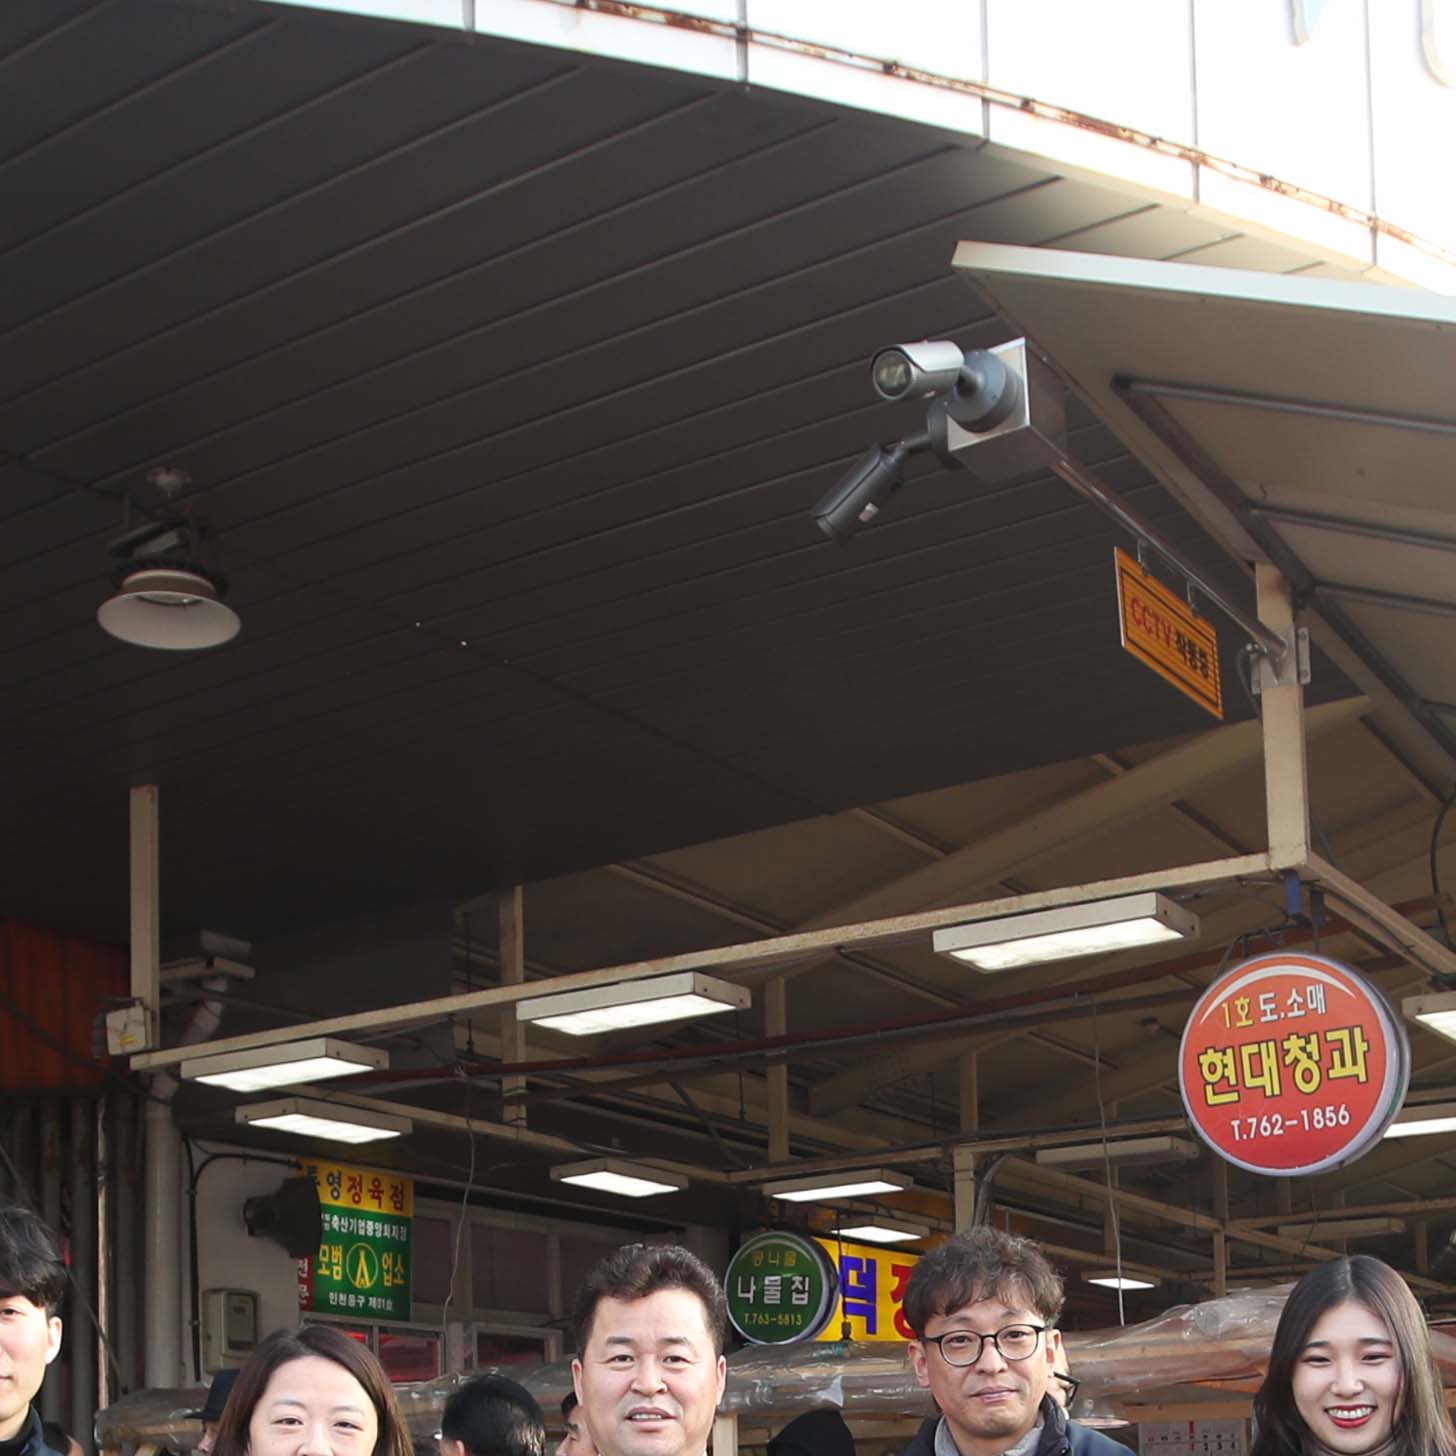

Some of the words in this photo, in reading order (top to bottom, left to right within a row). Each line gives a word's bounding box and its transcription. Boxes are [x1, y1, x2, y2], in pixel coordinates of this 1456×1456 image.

[1221, 996, 1253, 1029] 1호
[1198, 1025, 1369, 1107] 현대청과
[1231, 1104, 1350, 1141] T.762-1856
[318, 1244, 343, 1280] 모범
[382, 1252, 405, 1287] 업소
[737, 1275, 810, 1305] 나물집
